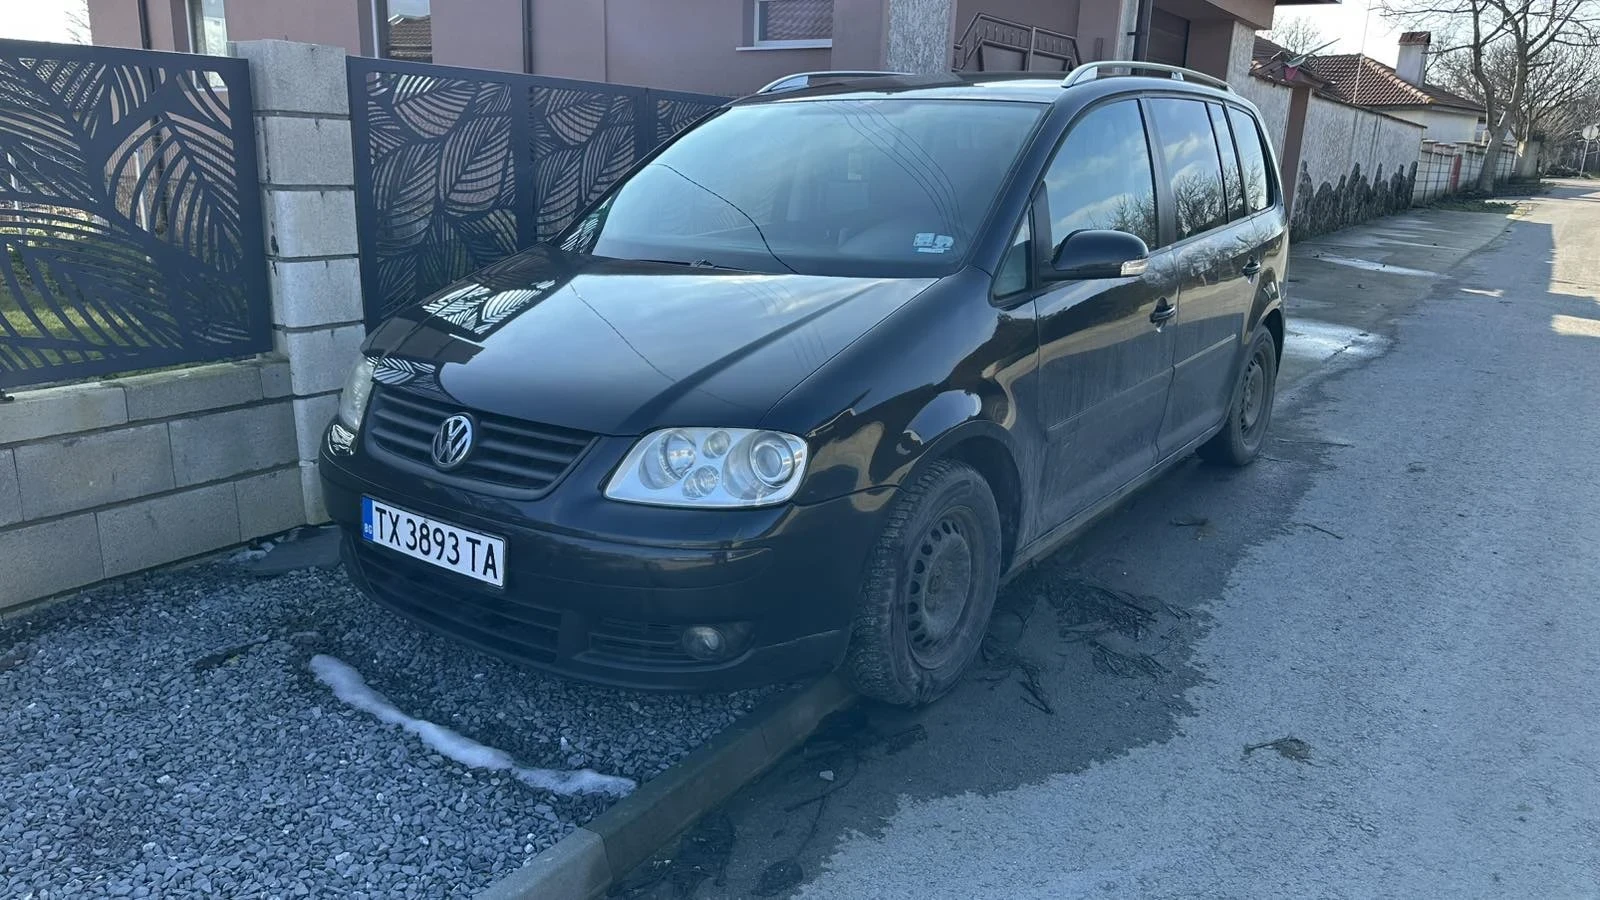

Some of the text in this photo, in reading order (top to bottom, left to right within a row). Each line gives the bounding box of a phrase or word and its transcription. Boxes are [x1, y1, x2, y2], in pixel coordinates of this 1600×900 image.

[375, 506, 498, 579] TX 3893 TA
